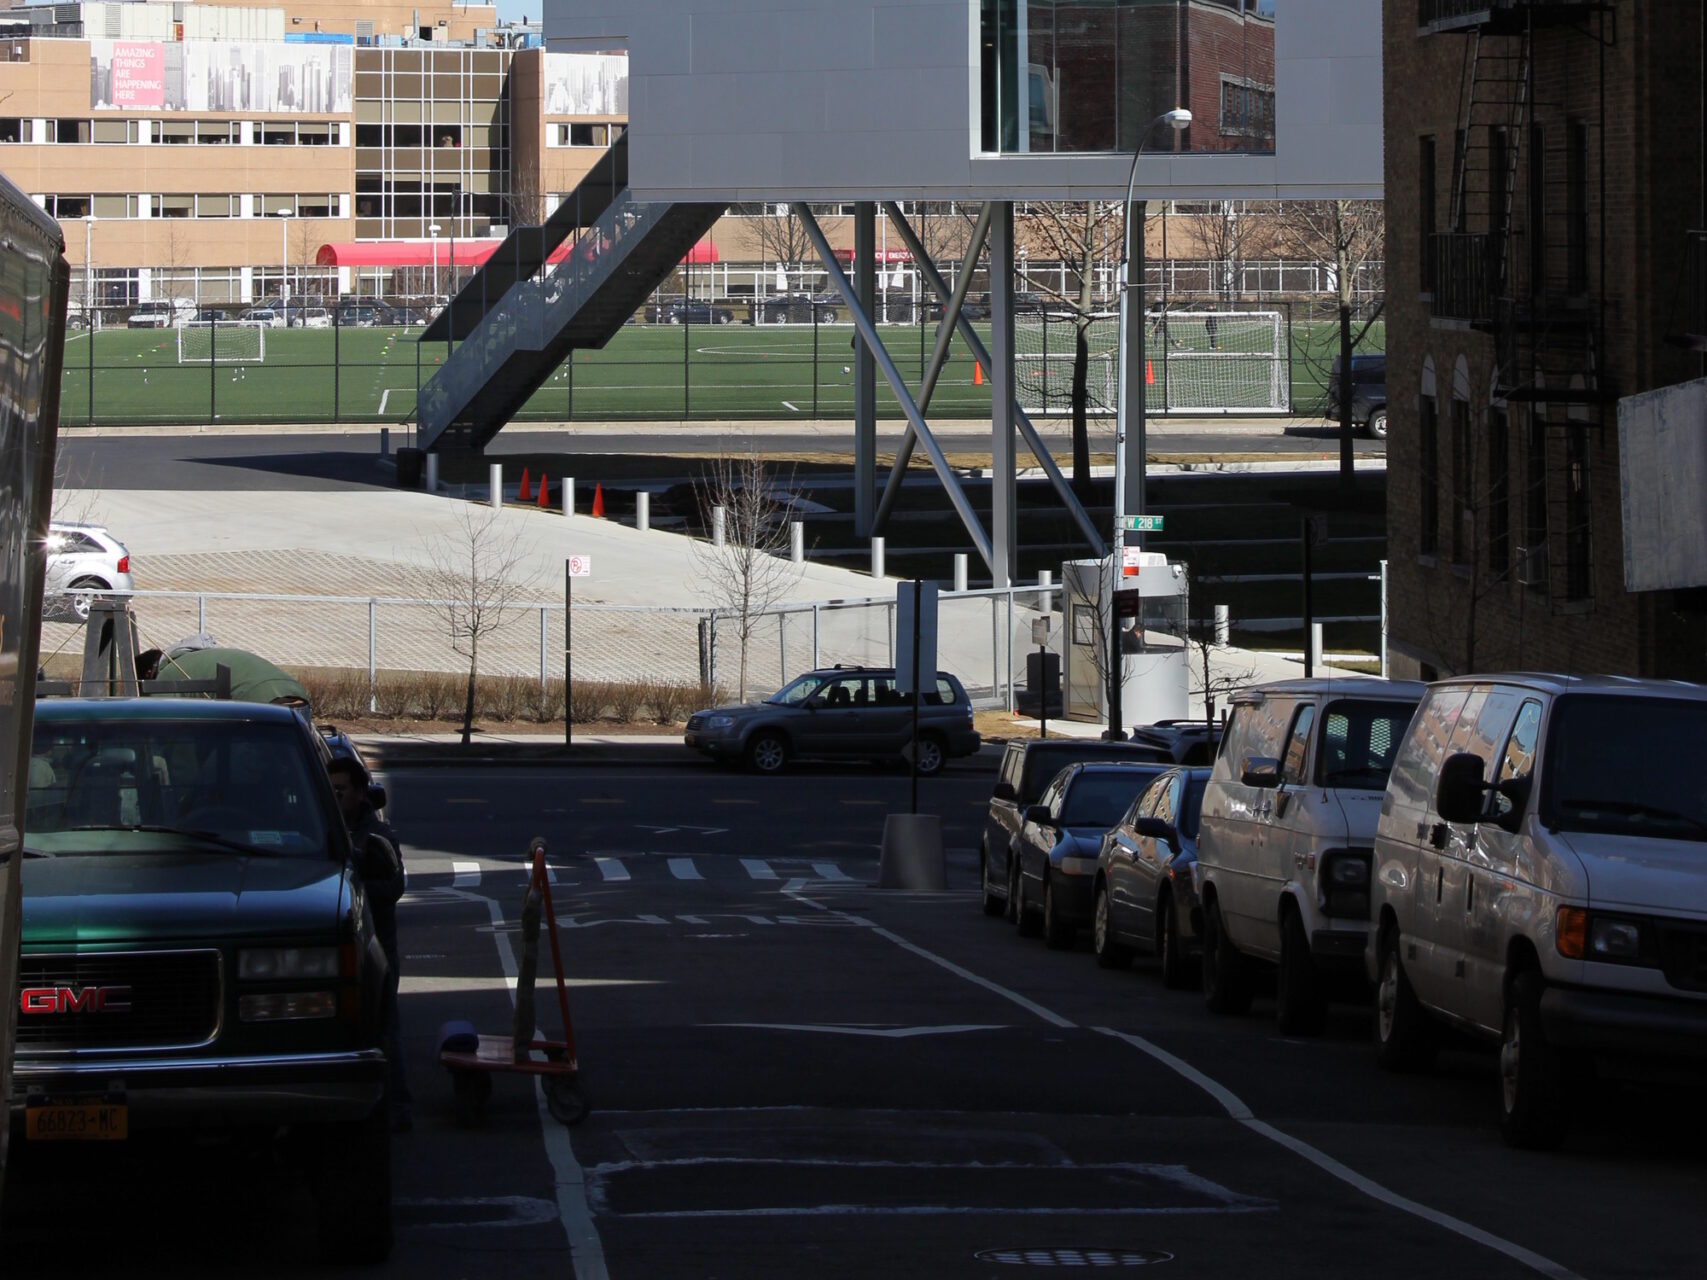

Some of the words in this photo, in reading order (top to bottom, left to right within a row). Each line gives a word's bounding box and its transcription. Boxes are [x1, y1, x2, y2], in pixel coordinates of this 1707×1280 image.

[115, 48, 155, 58] AMAZING
[115, 58, 145, 68] THINGS
[115, 69, 130, 78] ARE
[115, 80, 161, 90] HAPPENING
[115, 90, 135, 99] HERE
[1127, 517, 1136, 529] W
[1138, 517, 1153, 529] 218
[21, 986, 131, 1013] GMC
